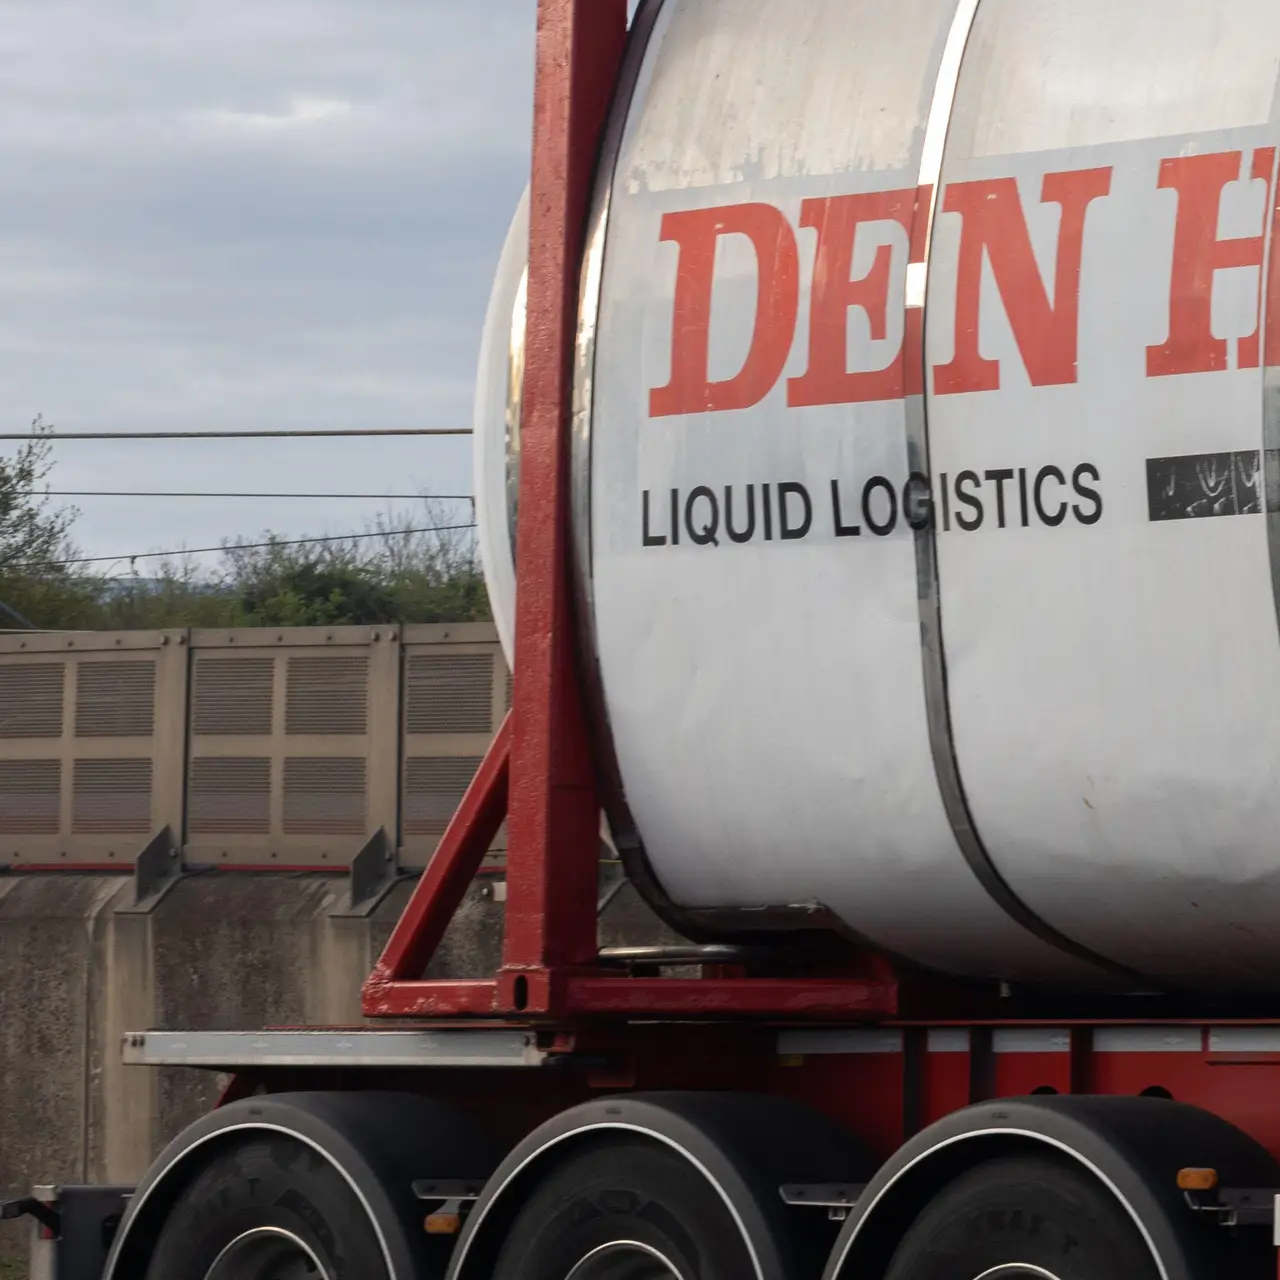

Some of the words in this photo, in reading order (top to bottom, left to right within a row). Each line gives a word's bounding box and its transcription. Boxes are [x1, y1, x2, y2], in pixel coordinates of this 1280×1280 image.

[649, 165, 1112, 418] DEN
[641, 480, 813, 547] LIQUID
[831, 462, 1103, 539] LOGISTICS
